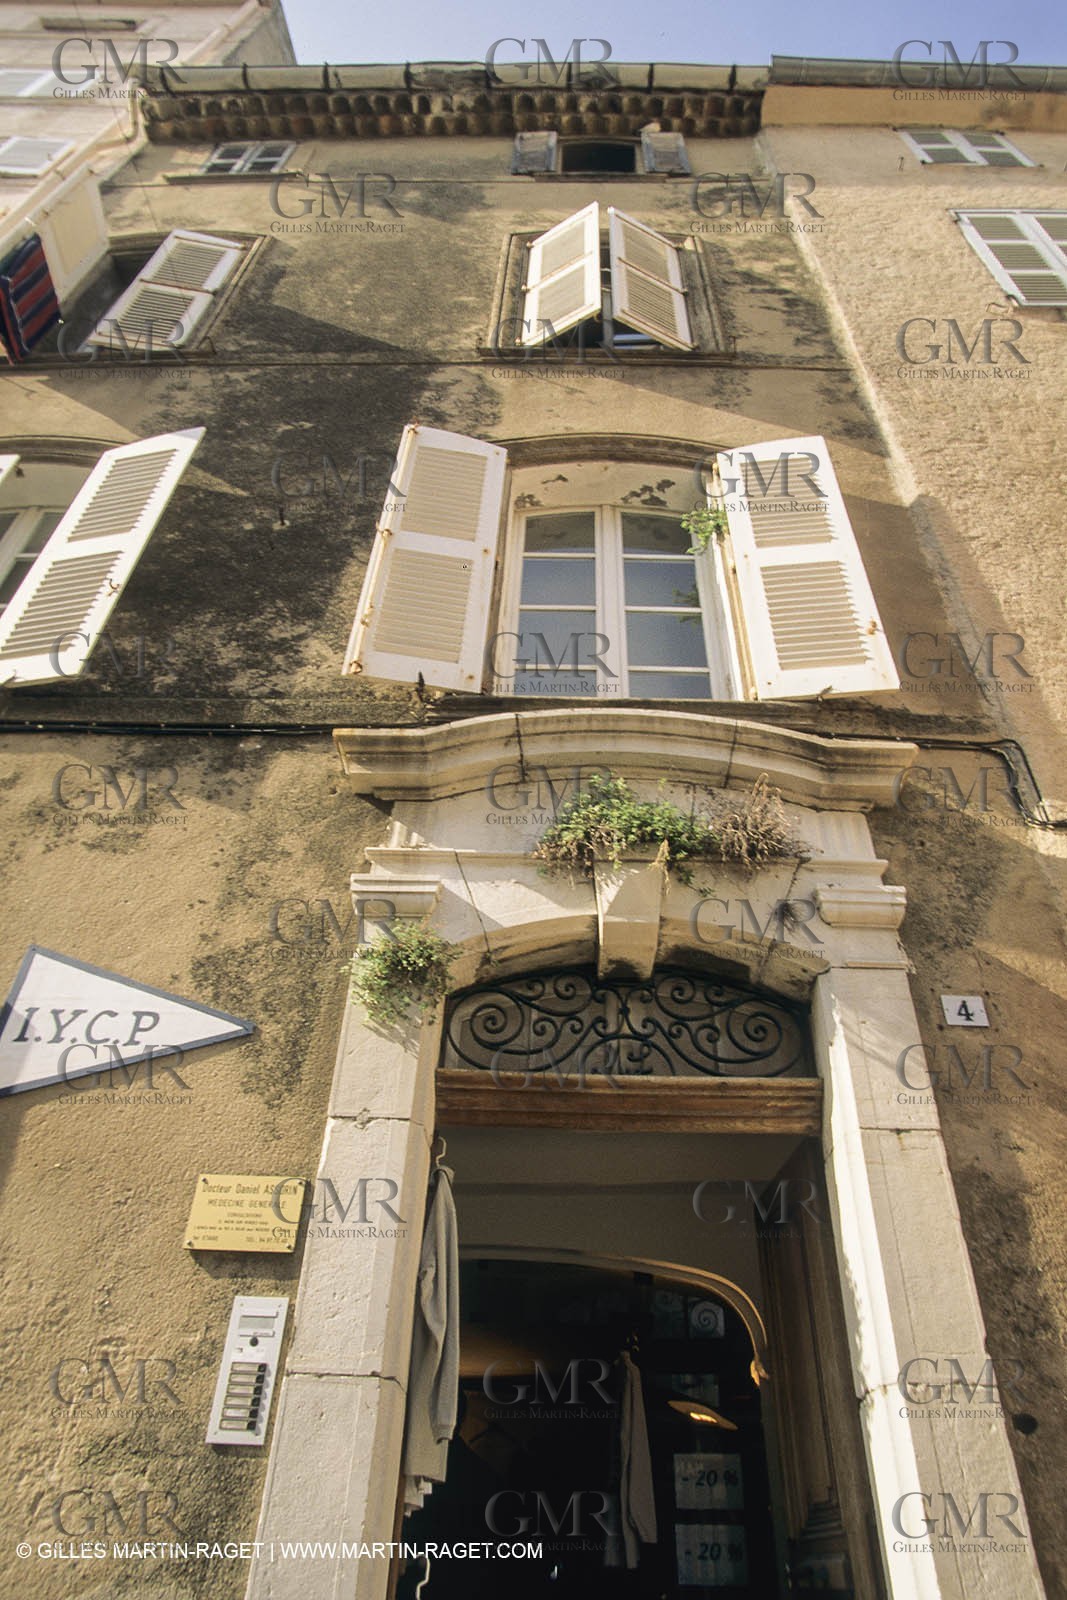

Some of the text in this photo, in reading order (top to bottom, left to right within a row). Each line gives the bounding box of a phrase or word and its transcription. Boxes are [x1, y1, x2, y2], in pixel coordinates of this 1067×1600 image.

[958, 1000, 974, 1022] 4
[12, 1007, 160, 1046] I.Y.C.P
[202, 1184, 232, 1193] Docteur
[236, 1184, 260, 1194] Daniel
[696, 1470, 718, 1487] 20
[698, 1543, 721, 1561] 20
